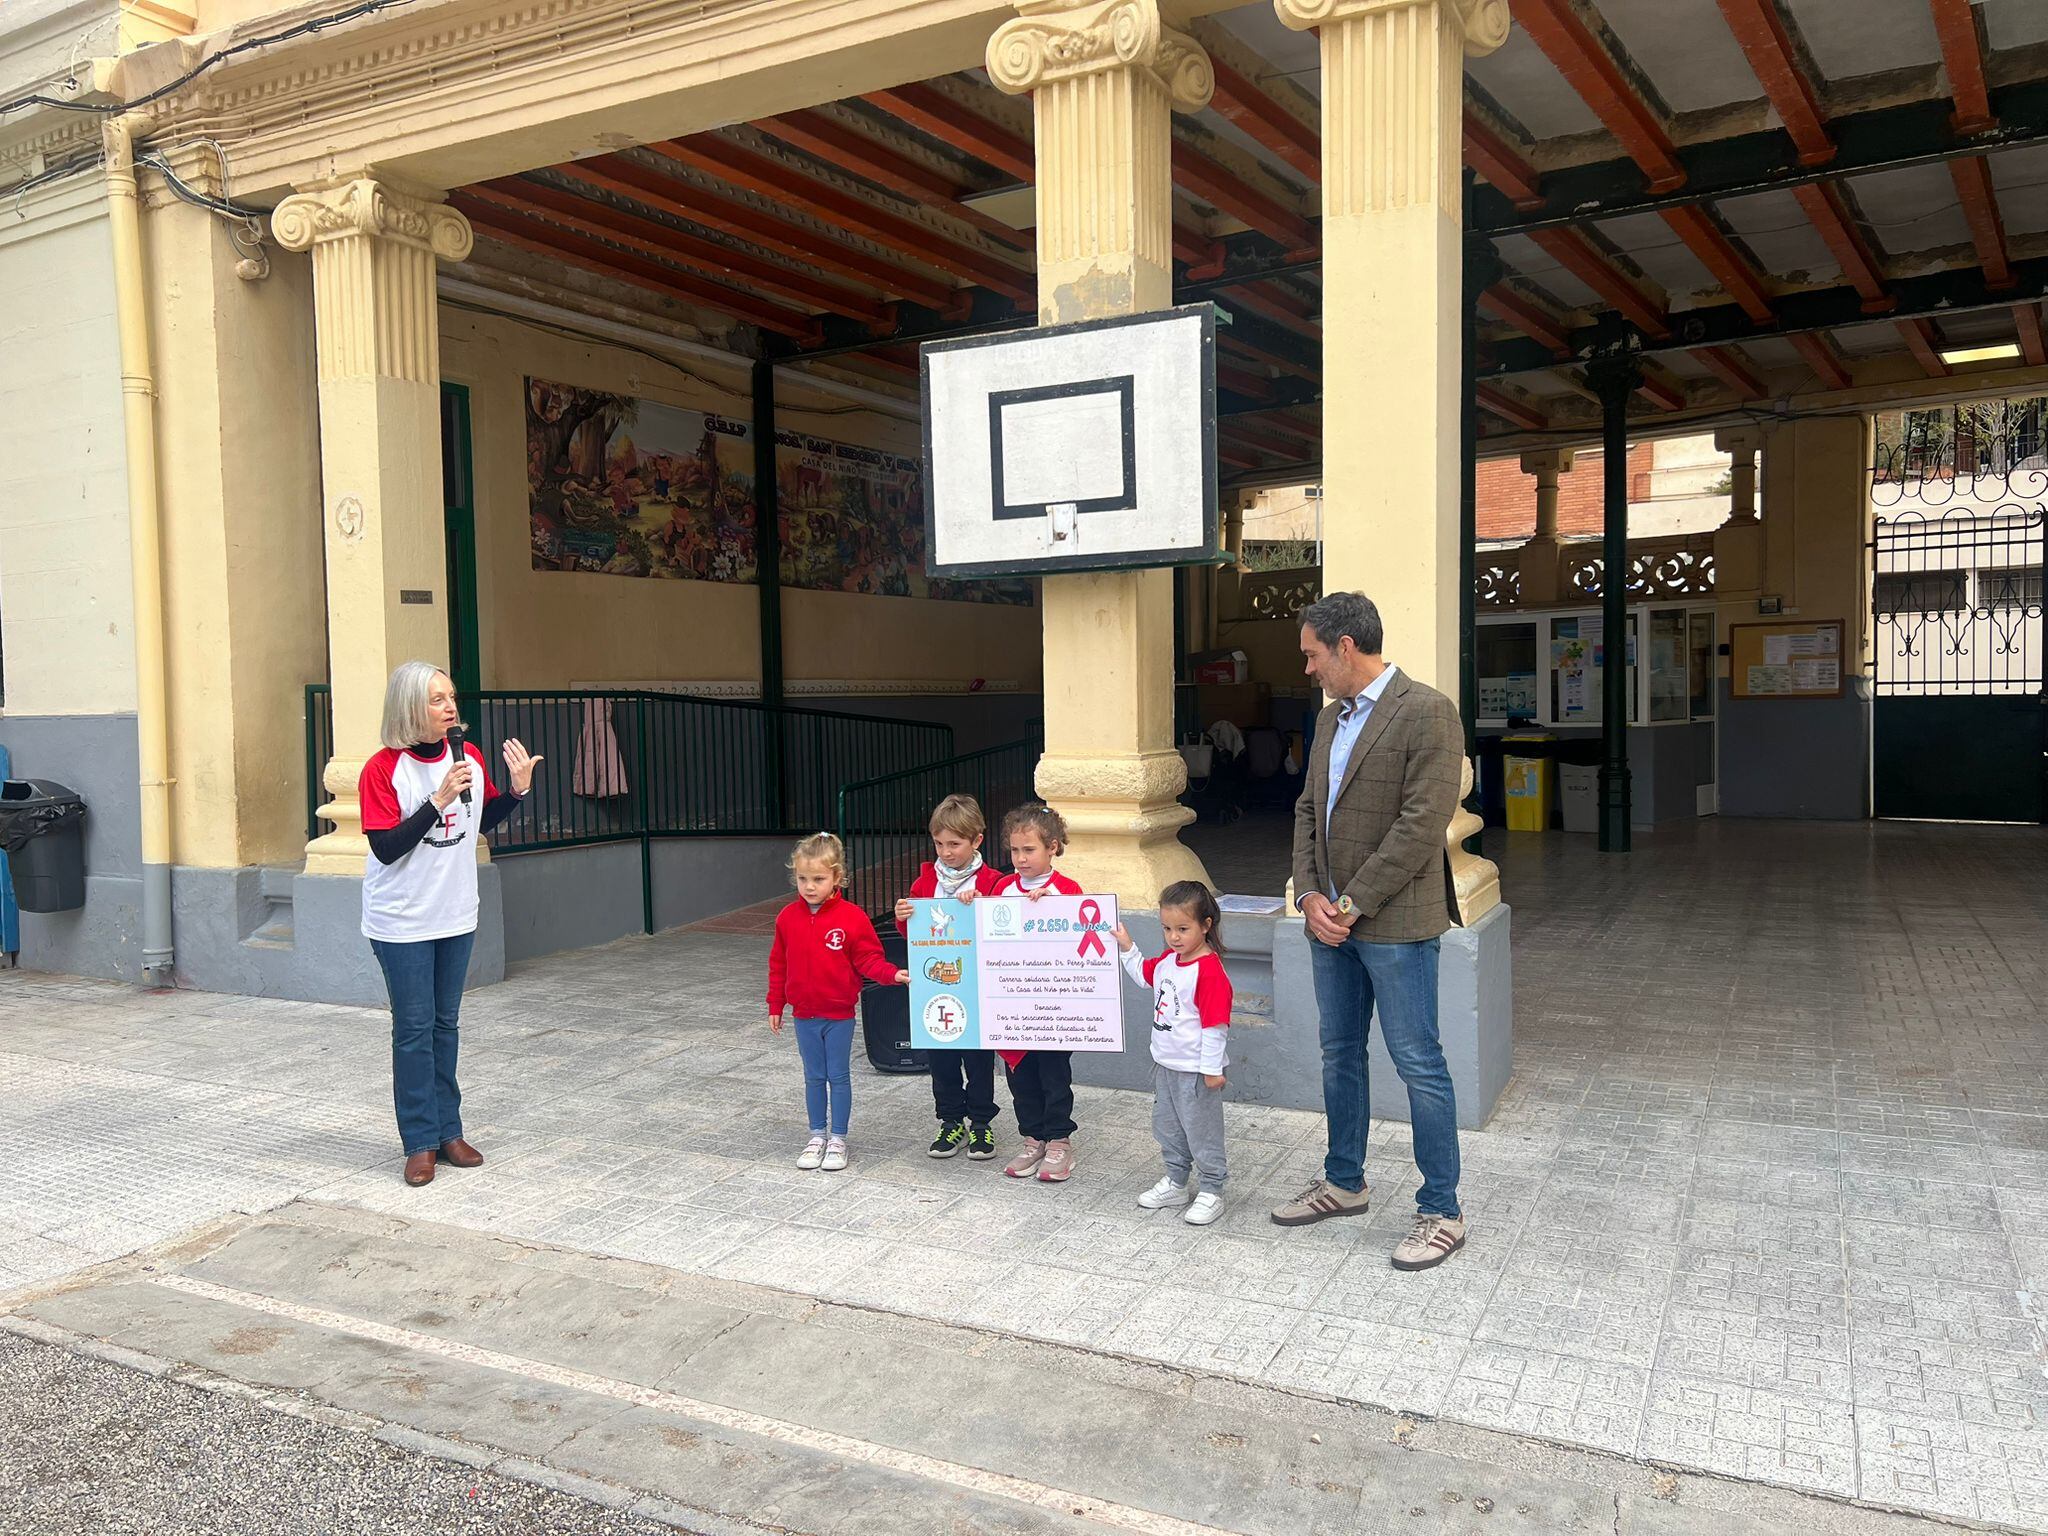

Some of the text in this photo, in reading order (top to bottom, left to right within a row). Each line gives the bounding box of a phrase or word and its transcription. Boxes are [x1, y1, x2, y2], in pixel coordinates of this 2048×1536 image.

[774, 432, 803, 449] NOS.
[807, 438, 832, 455] SAN
[883, 455, 893, 468] Y
[802, 456, 821, 468] CASA
[823, 462, 836, 472] DEL
[838, 463, 857, 475] NIÑO
[1037, 918, 1070, 933] 2.650
[1072, 920, 1112, 932] euros
[1022, 959, 1052, 968] Fundación
[998, 975, 1022, 983] Carrera
[1053, 975, 1071, 983] Curso
[1059, 987, 1071, 995] por
[1034, 1003, 1062, 1011] Donación
[988, 1034, 1003, 1042] CEIP
[1020, 1034, 1033, 1042] San
[1034, 1034, 1057, 1042] Isidoro
[1065, 1035, 1083, 1043] Santa
[1084, 1035, 1115, 1043] Florentina
